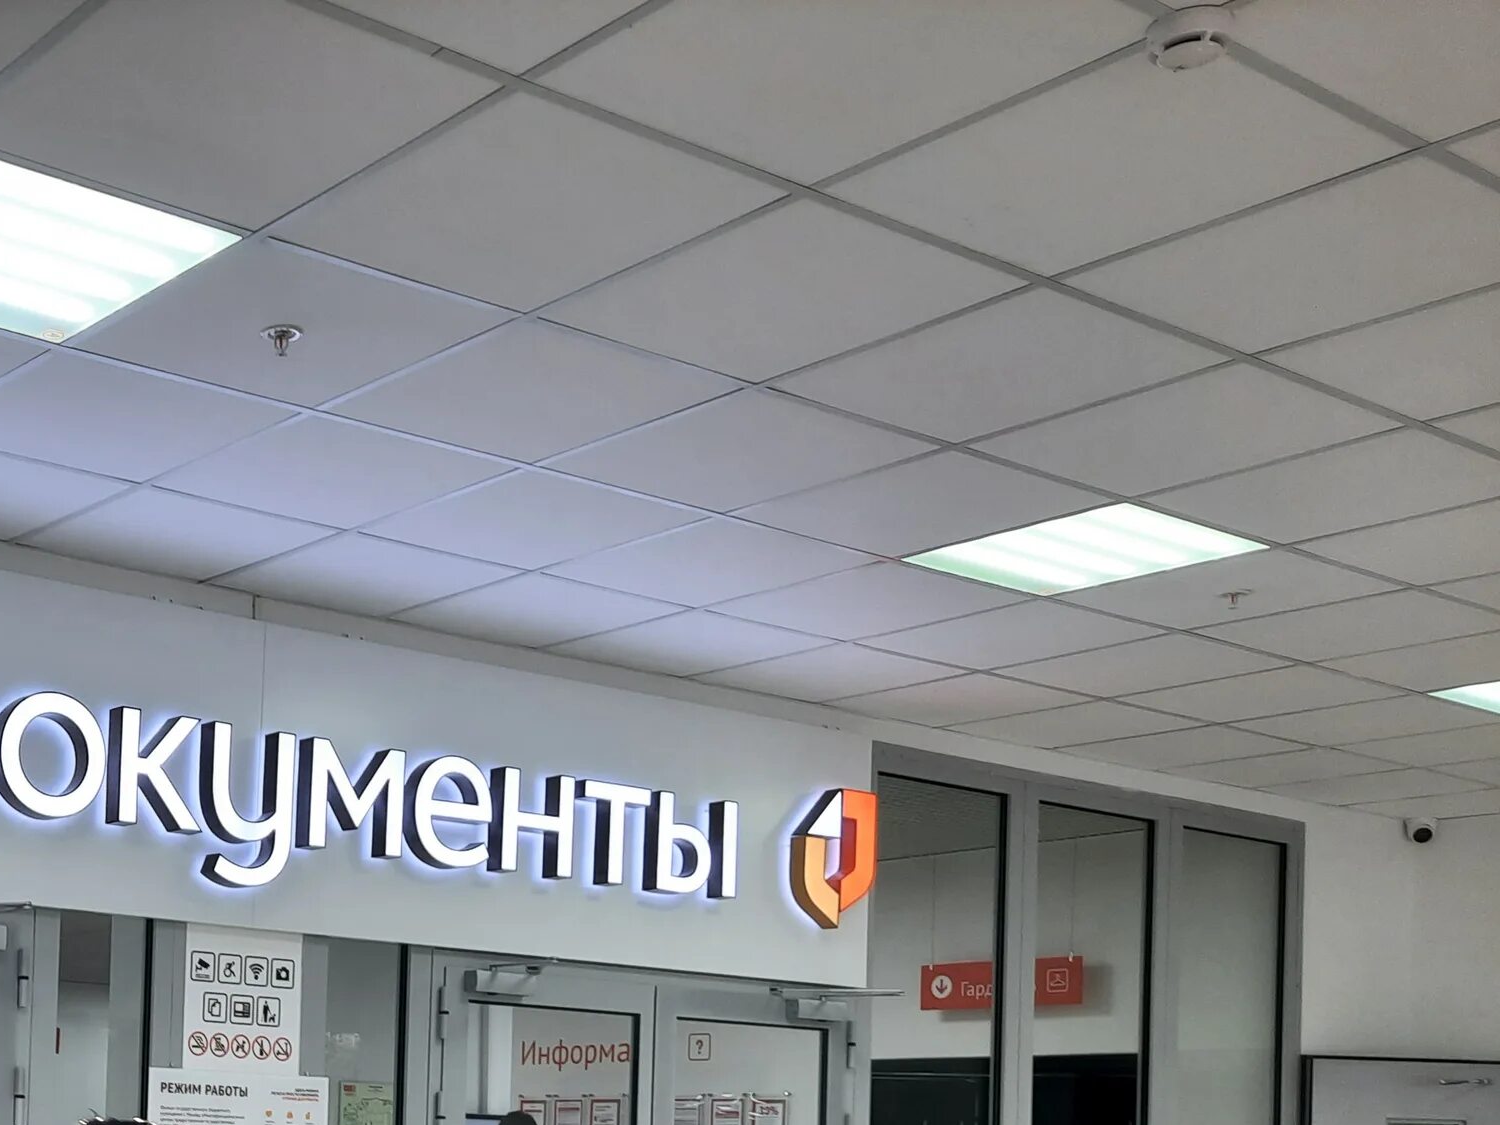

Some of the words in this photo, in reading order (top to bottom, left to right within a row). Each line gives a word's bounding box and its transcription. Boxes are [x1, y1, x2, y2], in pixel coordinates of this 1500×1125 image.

[521, 1038, 630, 1072] Информа
[160, 1081, 202, 1095] РЕЖИМ
[204, 1084, 248, 1098] РАБОТЫ
